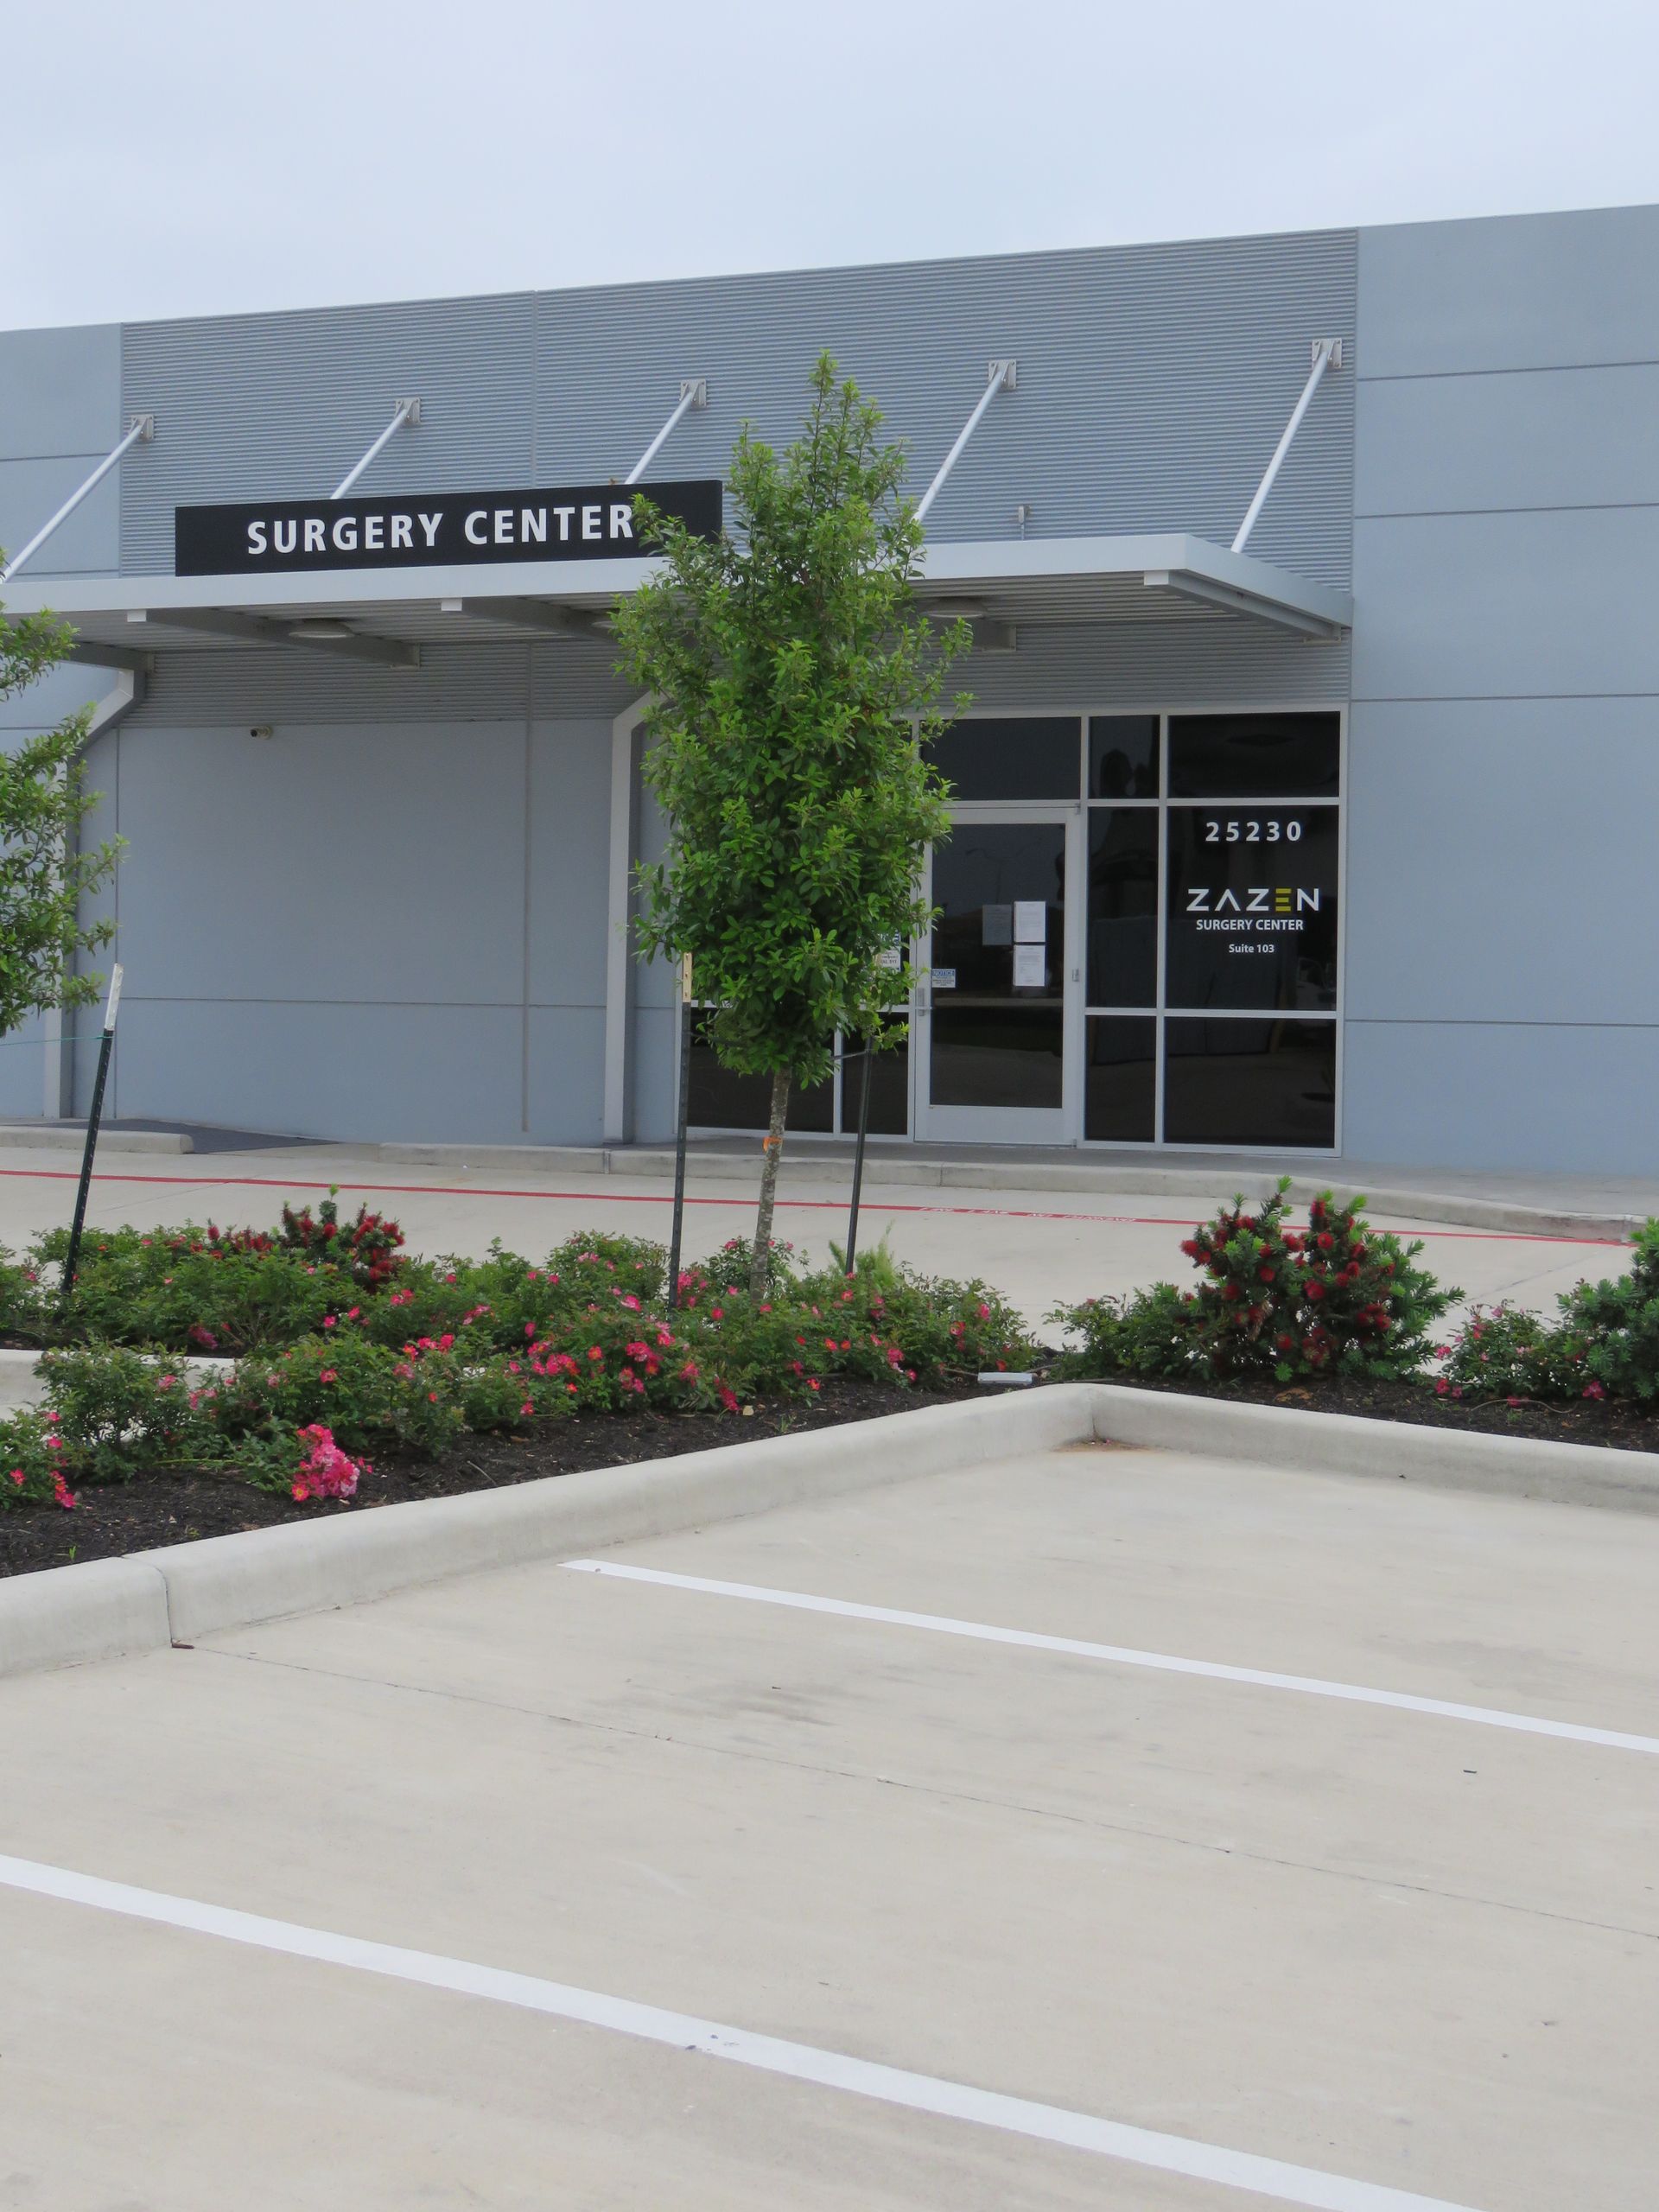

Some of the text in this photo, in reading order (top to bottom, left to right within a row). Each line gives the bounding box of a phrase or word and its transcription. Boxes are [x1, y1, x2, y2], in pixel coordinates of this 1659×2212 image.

[247, 504, 634, 555] SURGERY CENTER
[1205, 821, 1301, 842] 25230
[1186, 888, 1319, 912] ZAZEN
[1196, 918, 1304, 931] SURGERY CENTER
[1228, 944, 1275, 954] Suite 103
